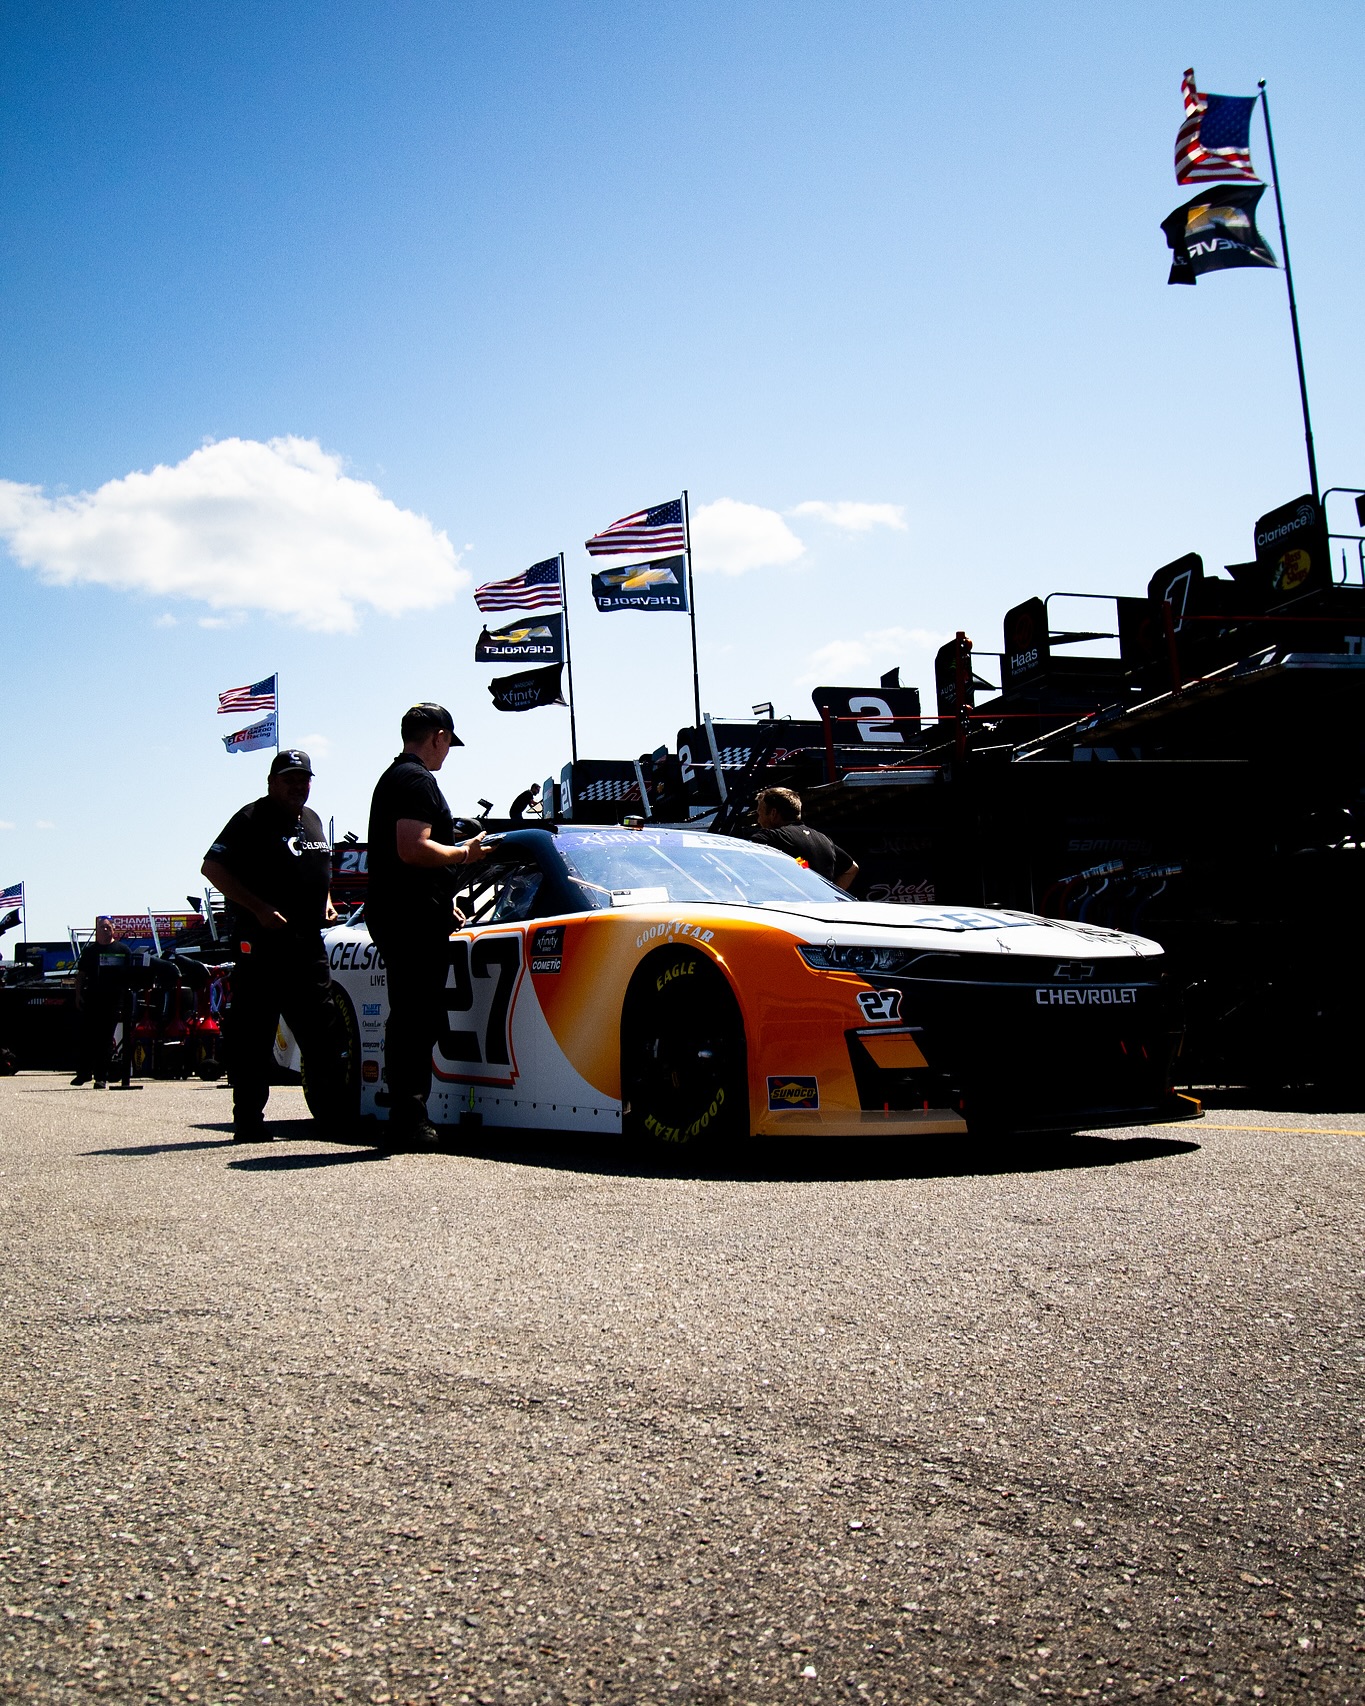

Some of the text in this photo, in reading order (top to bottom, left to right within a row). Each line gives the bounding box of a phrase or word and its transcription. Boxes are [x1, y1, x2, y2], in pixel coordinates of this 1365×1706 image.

[1257, 515, 1308, 546] Clarience
[1011, 648, 1038, 669] Haas
[502, 688, 541, 704] xfinity
[849, 697, 904, 743] 2
[247, 732, 271, 740] Racing
[679, 744, 696, 783] 2
[577, 831, 661, 846] xfinity
[537, 935, 558, 949] xfinity
[636, 919, 715, 949] GOODYEAR
[532, 958, 561, 970] COMETIC
[370, 974, 386, 986] LIVE
[656, 961, 697, 992] EAGLE
[857, 990, 902, 1021] 27
[1035, 988, 1138, 1005] CHEVROLET
[771, 1087, 816, 1099] SUNOCO
[644, 1087, 725, 1144] GOODYEAR
